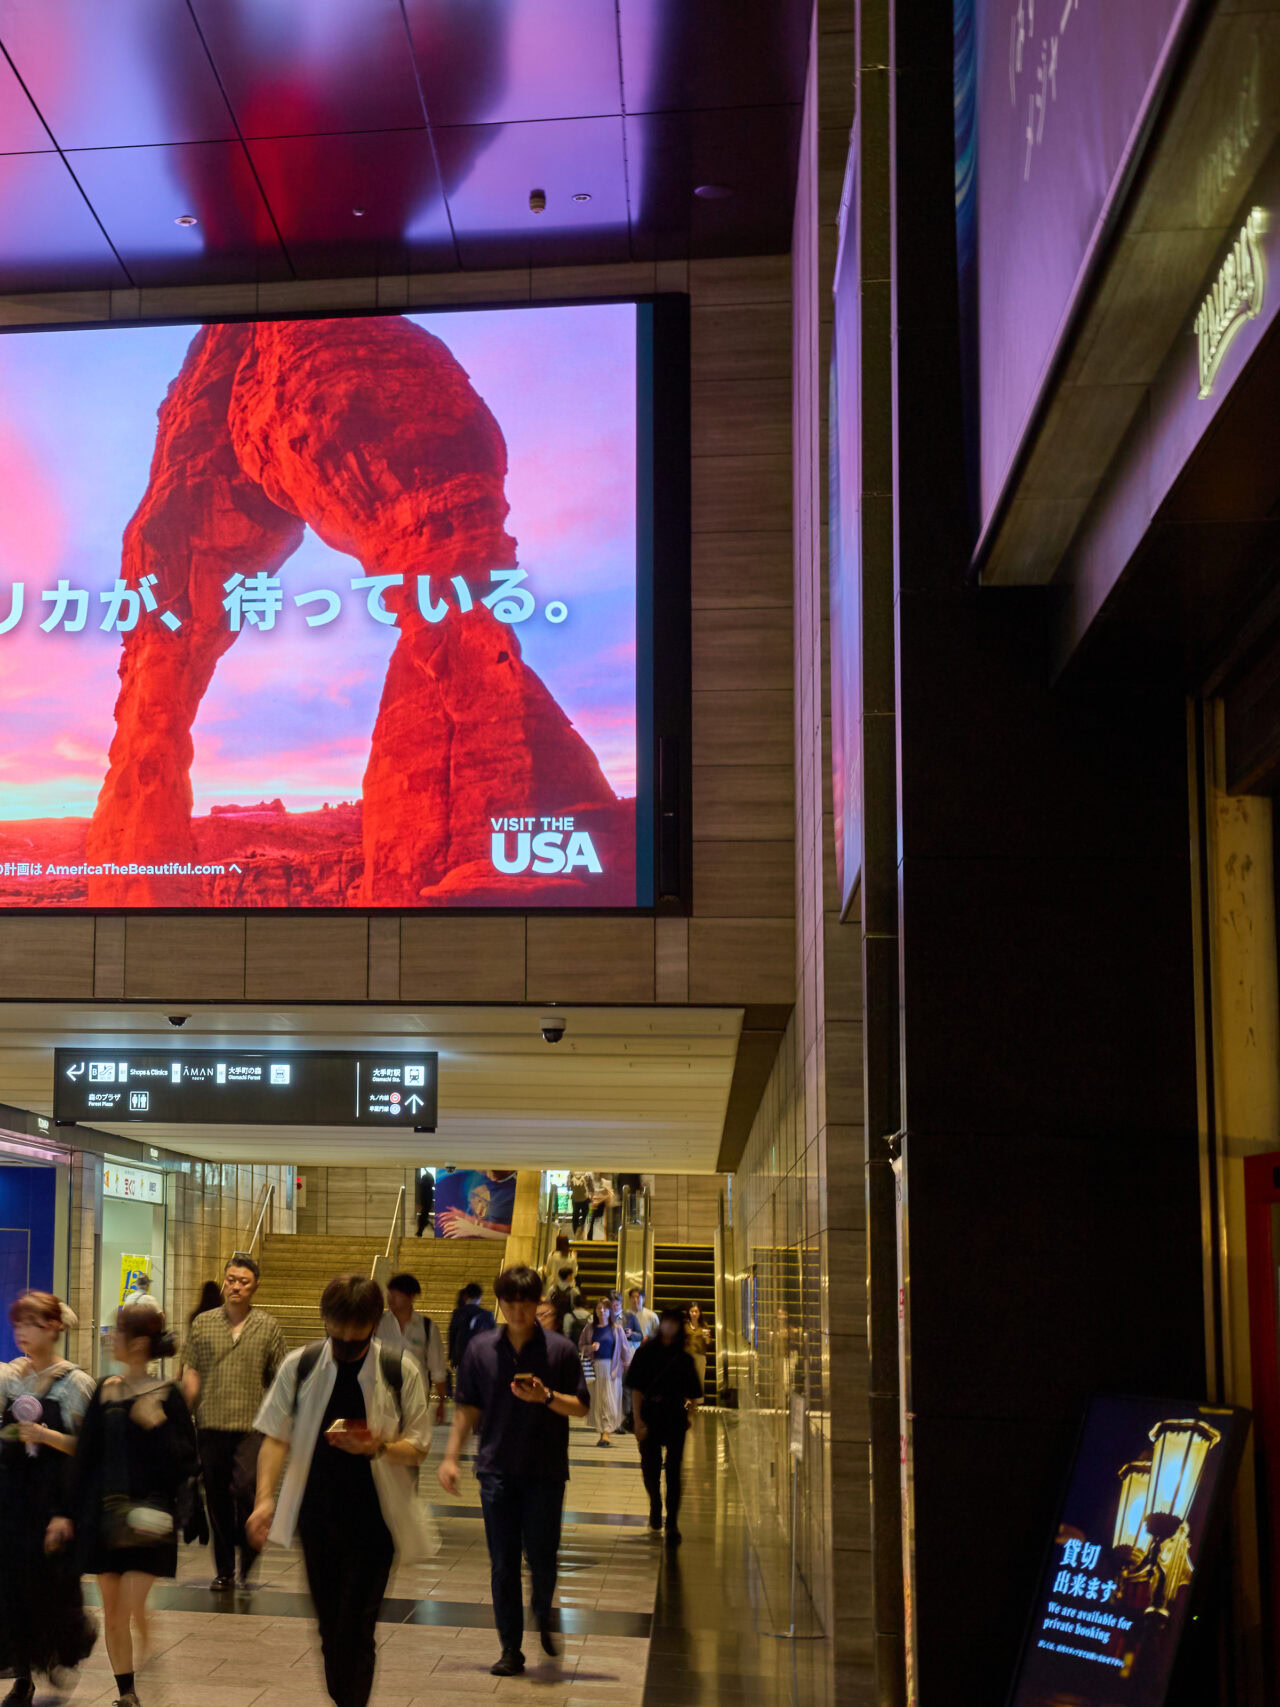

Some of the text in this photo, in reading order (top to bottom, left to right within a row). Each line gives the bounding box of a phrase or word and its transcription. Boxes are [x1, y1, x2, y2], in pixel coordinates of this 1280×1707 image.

[490, 817, 574, 831] VISIT THE
[491, 832, 603, 874] USA
[46, 863, 225, 875] AmericaTheBeautiful.com
[228, 863, 242, 875] へ
[130, 1069, 146, 1077] Shops
[228, 1067, 261, 1075] 大手町の森
[372, 1069, 401, 1077] 大手町駅
[1060, 1538, 1101, 1570] 貸切
[1053, 1570, 1117, 1602] 出来ます
[1048, 1601, 1133, 1631] We are available for
[1042, 1618, 1111, 1644] private booking
